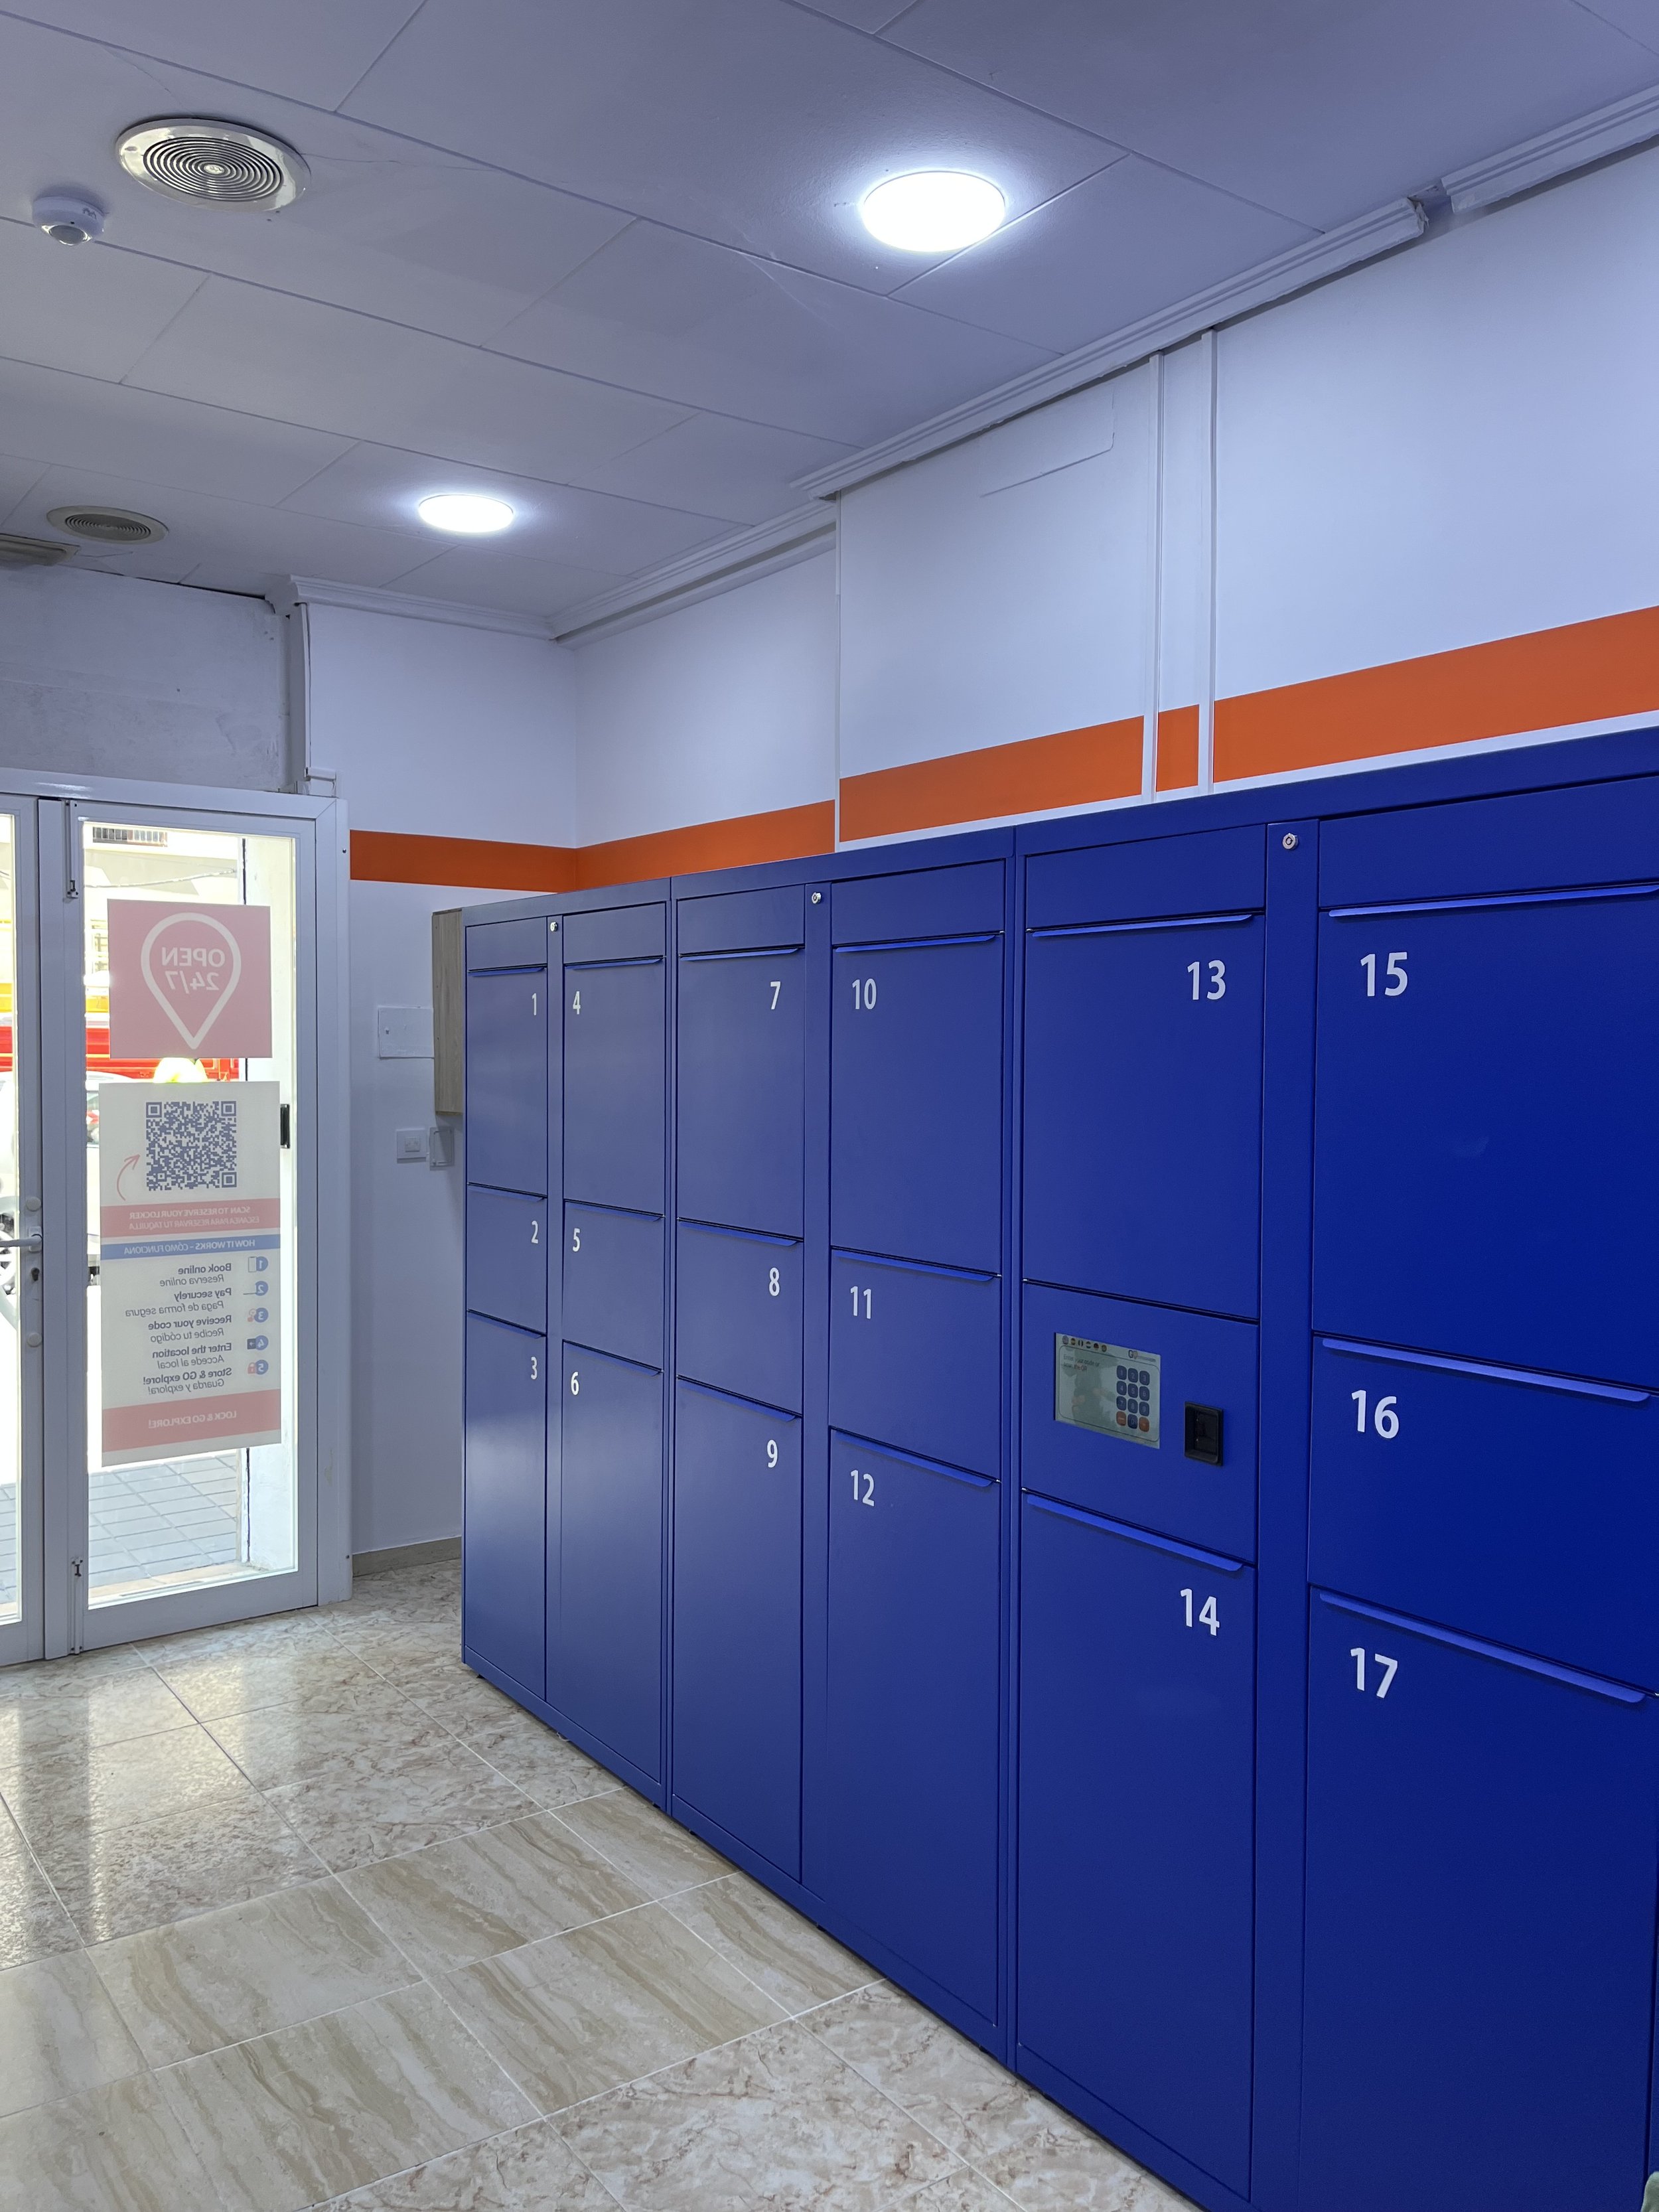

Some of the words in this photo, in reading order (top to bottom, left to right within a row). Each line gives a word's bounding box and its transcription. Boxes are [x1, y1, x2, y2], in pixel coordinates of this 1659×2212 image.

[1187, 960, 1226, 1000] 13
[1360, 952, 1408, 997] 15
[532, 993, 538, 1016] 1
[573, 991, 581, 1015] 4
[770, 981, 781, 1010] 7
[852, 978, 877, 1009] 10
[531, 1220, 539, 1244] 2
[572, 1228, 580, 1252] 5
[768, 1267, 780, 1296] 8
[850, 1286, 871, 1319] 11
[531, 1357, 538, 1380] 3
[571, 1371, 579, 1396] 6
[1351, 1390, 1399, 1439] 16
[766, 1439, 778, 1468] 9
[851, 1469, 875, 1507] 12
[1180, 1588, 1220, 1636] 14
[1350, 1647, 1398, 1698] 17
